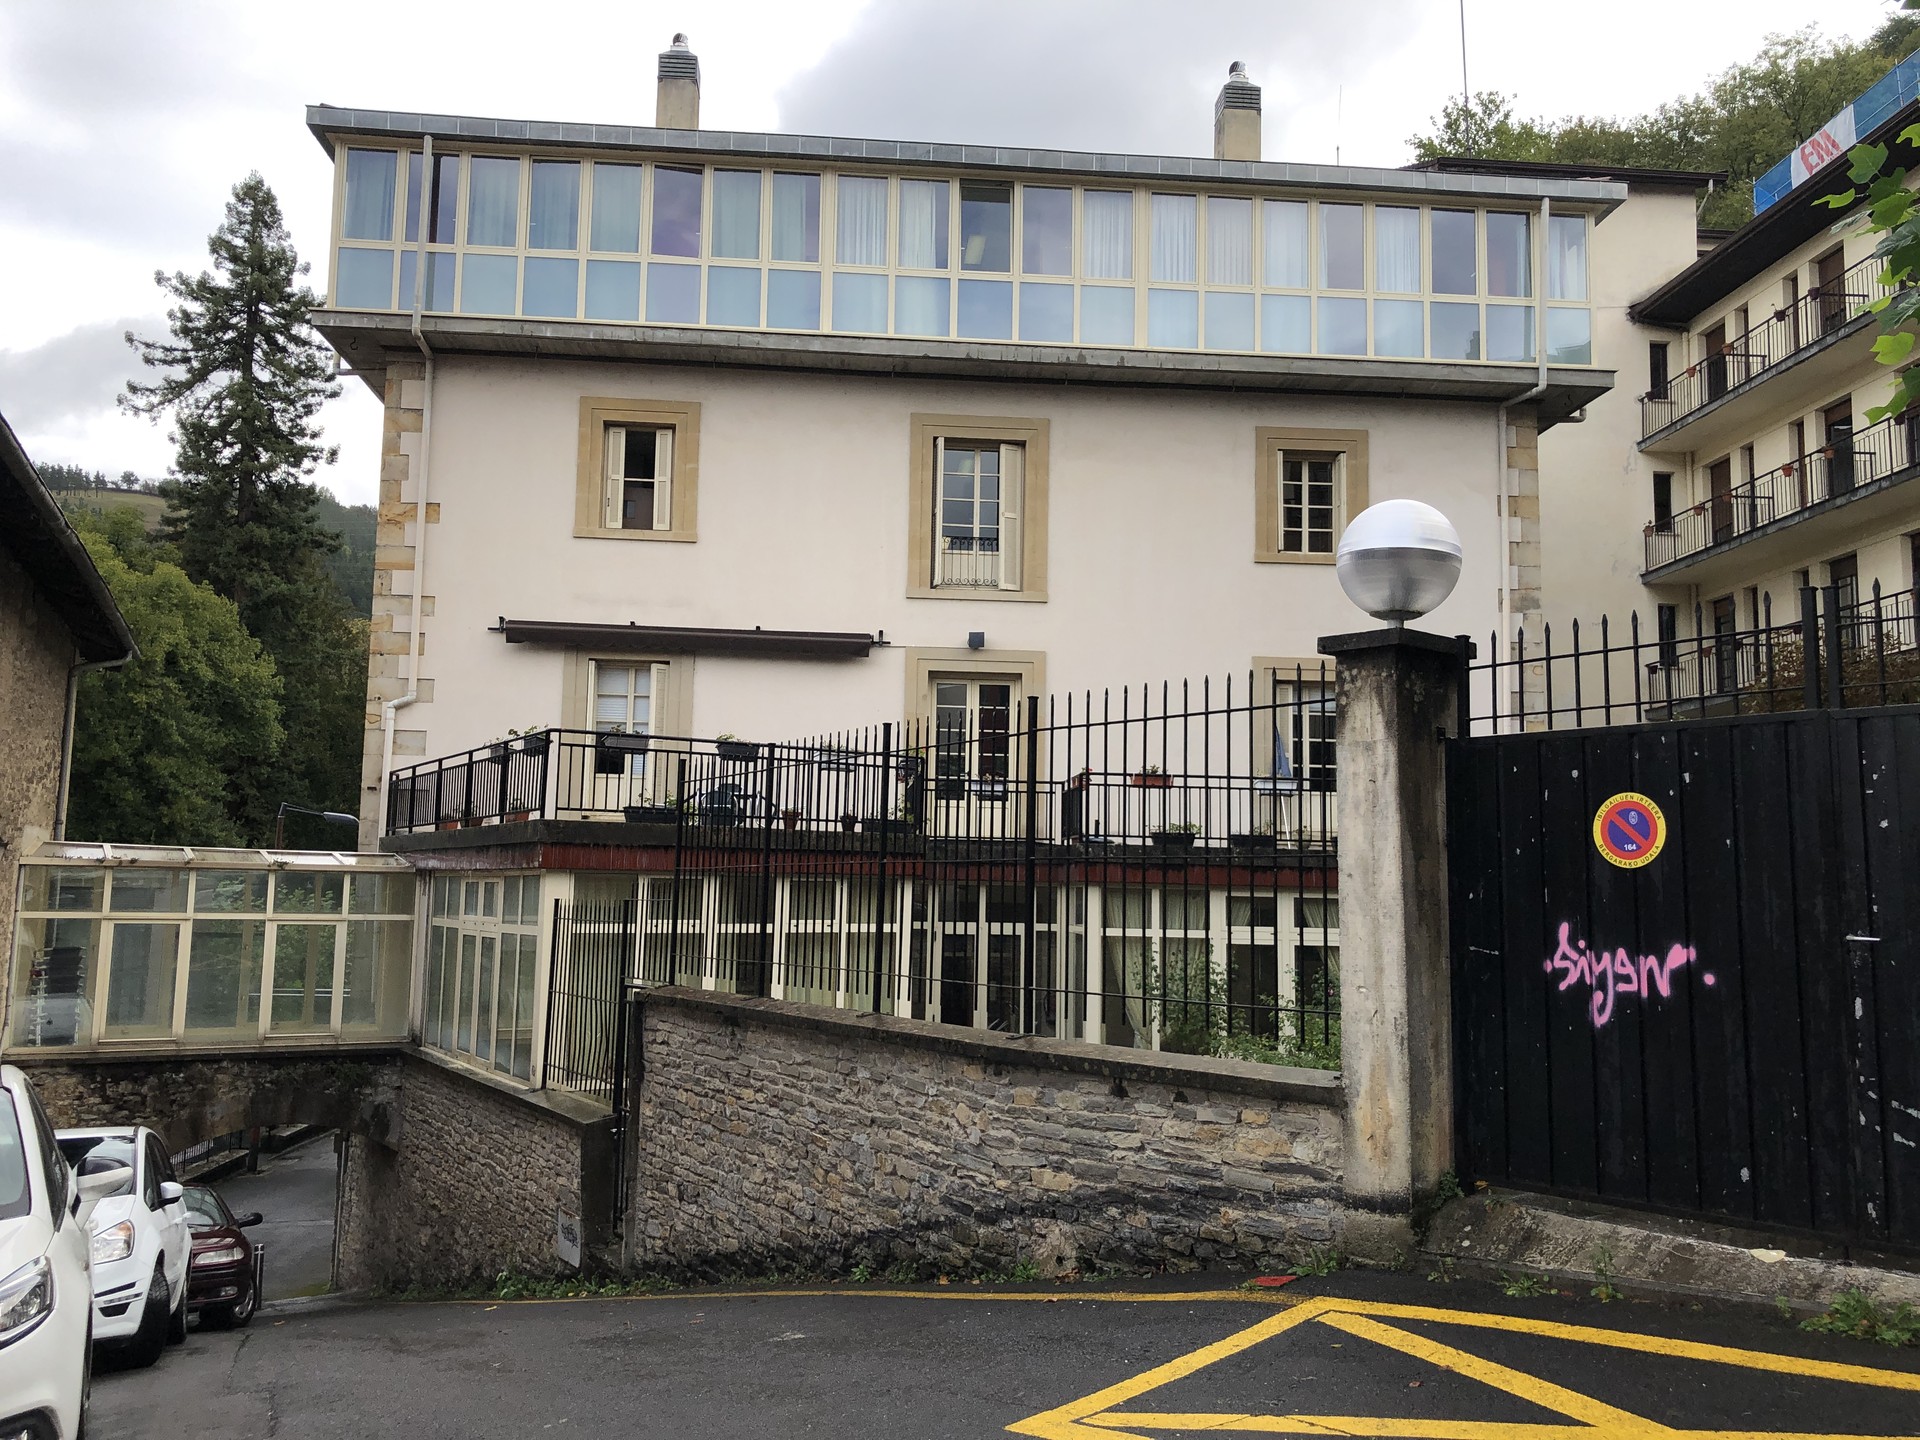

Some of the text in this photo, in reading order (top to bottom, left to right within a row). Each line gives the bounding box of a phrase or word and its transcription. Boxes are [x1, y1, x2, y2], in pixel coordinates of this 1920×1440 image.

[1596, 795, 1662, 822] IBILGAILUEN IRTEERA
[1599, 844, 1660, 867] BERGARAKO UDALA
